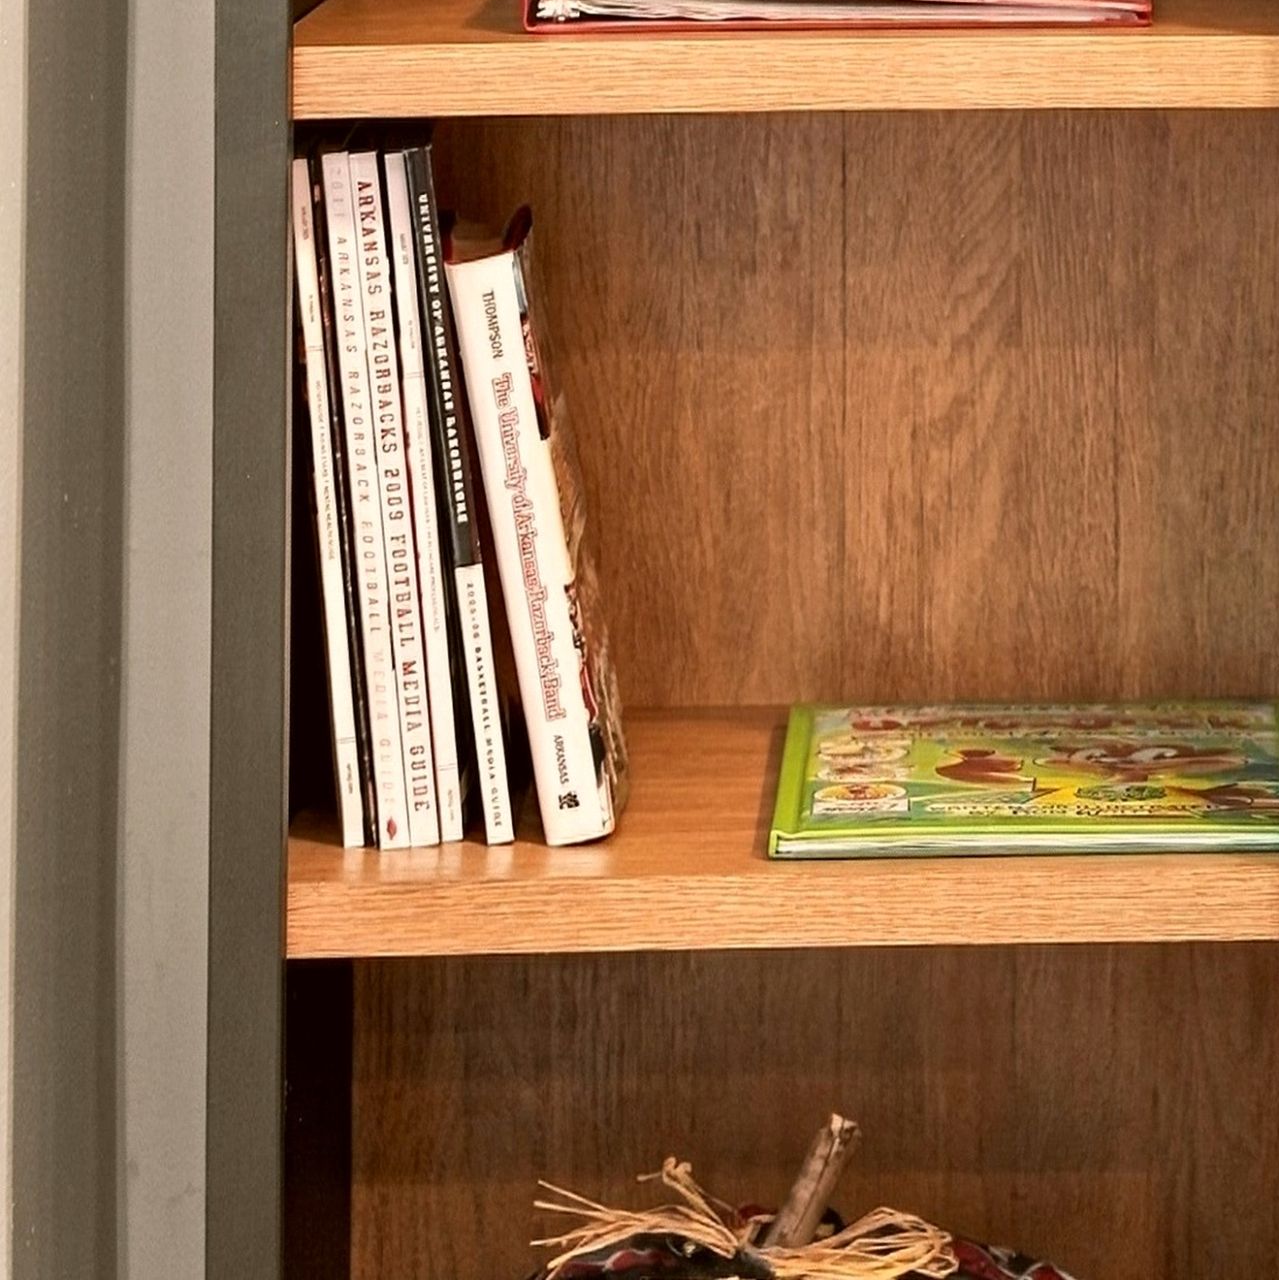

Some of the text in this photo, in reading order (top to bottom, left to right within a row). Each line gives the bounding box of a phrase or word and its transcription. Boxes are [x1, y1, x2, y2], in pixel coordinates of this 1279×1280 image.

[418, 193, 440, 293] UNIVERSITY
[434, 325, 455, 411] ARKANSAS
[481, 290, 504, 359] THOMPSON
[493, 371, 515, 407] The
[336, 236, 359, 354] ARKANSAS
[348, 370, 370, 503] RAZORBACK
[361, 520, 382, 633] FOOTBALL
[500, 406, 527, 490] University
[357, 180, 430, 812] ARKANSAS RAZORBACKS 2009 FOOTBALL MEDIA GUIDE
[515, 511, 538, 593] Arkansas
[527, 587, 560, 674] Razorback
[474, 646, 491, 730] BASKETBALL
[485, 738, 496, 780] MEDIA
[491, 786, 503, 827] GUIDE
[542, 673, 567, 722] Band
[553, 733, 570, 785] ARKANSAS
